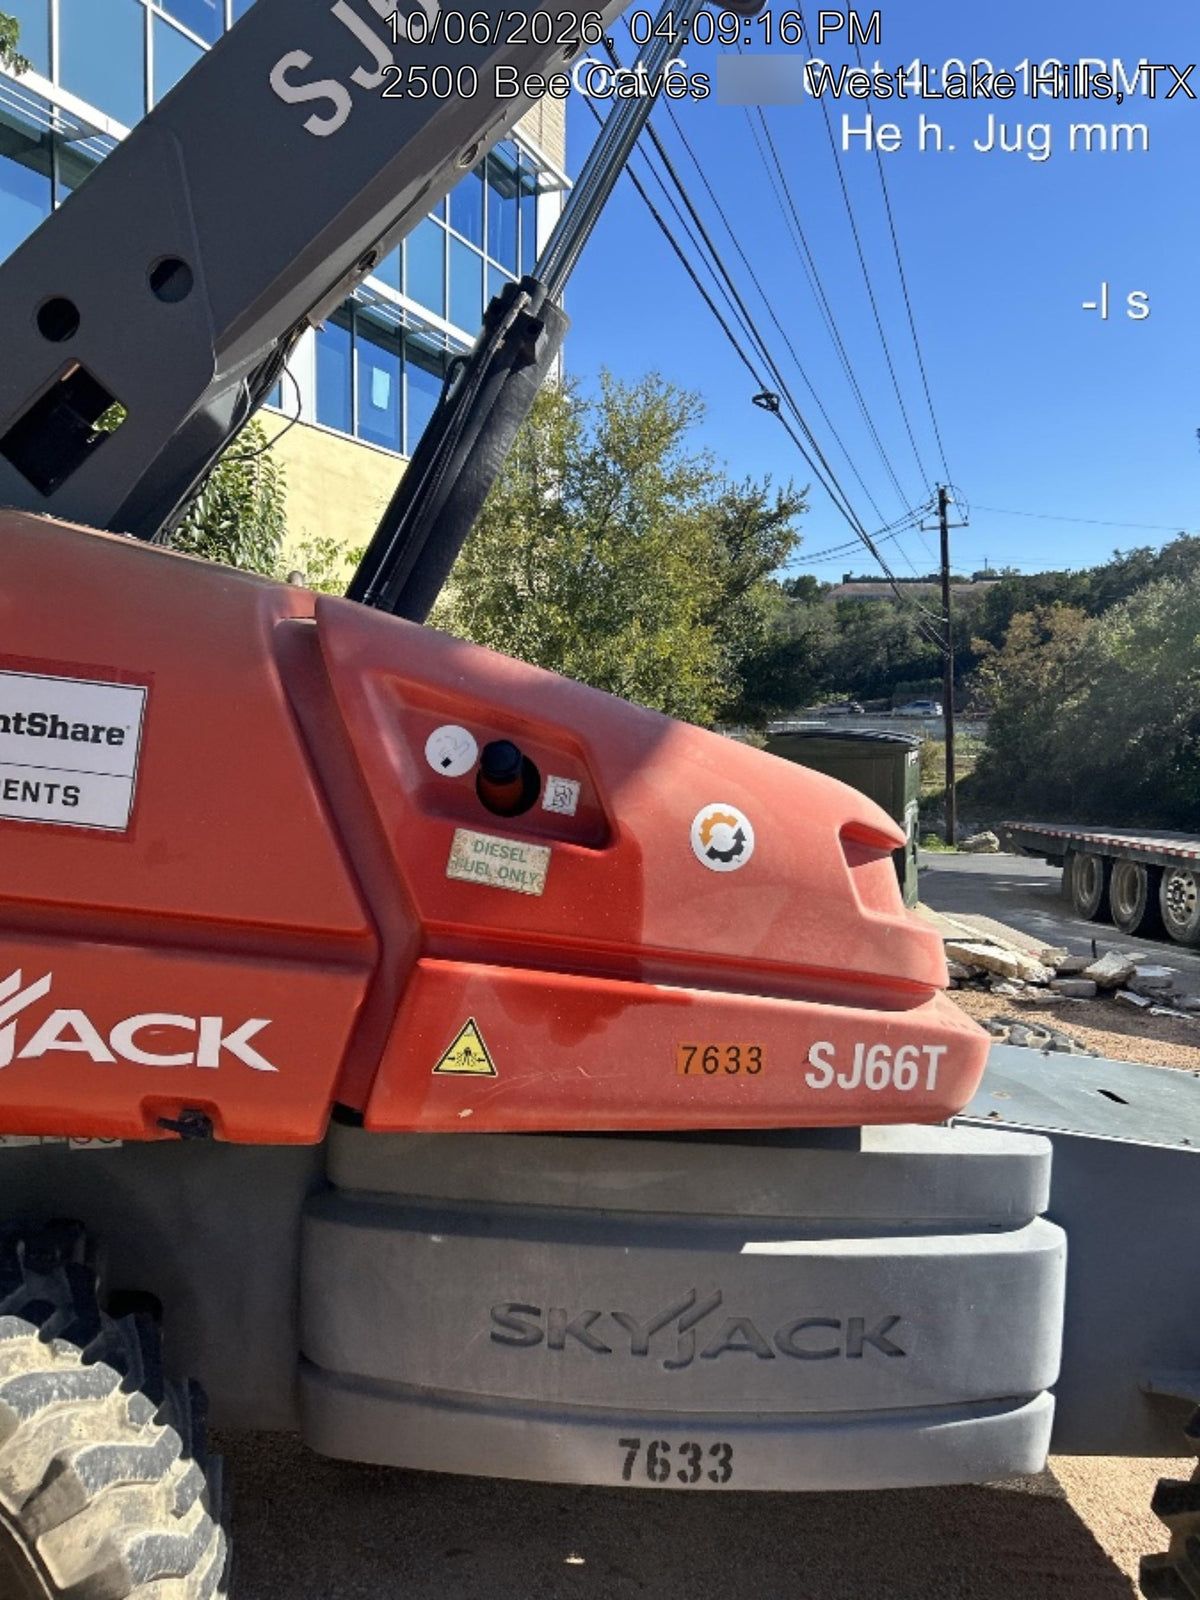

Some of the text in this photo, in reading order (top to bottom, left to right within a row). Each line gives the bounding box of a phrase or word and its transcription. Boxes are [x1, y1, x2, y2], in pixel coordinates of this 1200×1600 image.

[0, 778, 81, 807] ENTS
[473, 839, 528, 863] DIESEL
[454, 855, 540, 887] FUEL ONLY
[0, 968, 280, 1072] JACK
[681, 1045, 763, 1075] 7633
[804, 1041, 947, 1091] SJ66T
[490, 1288, 906, 1370] SKYJACK
[618, 1437, 734, 1484] 7633
